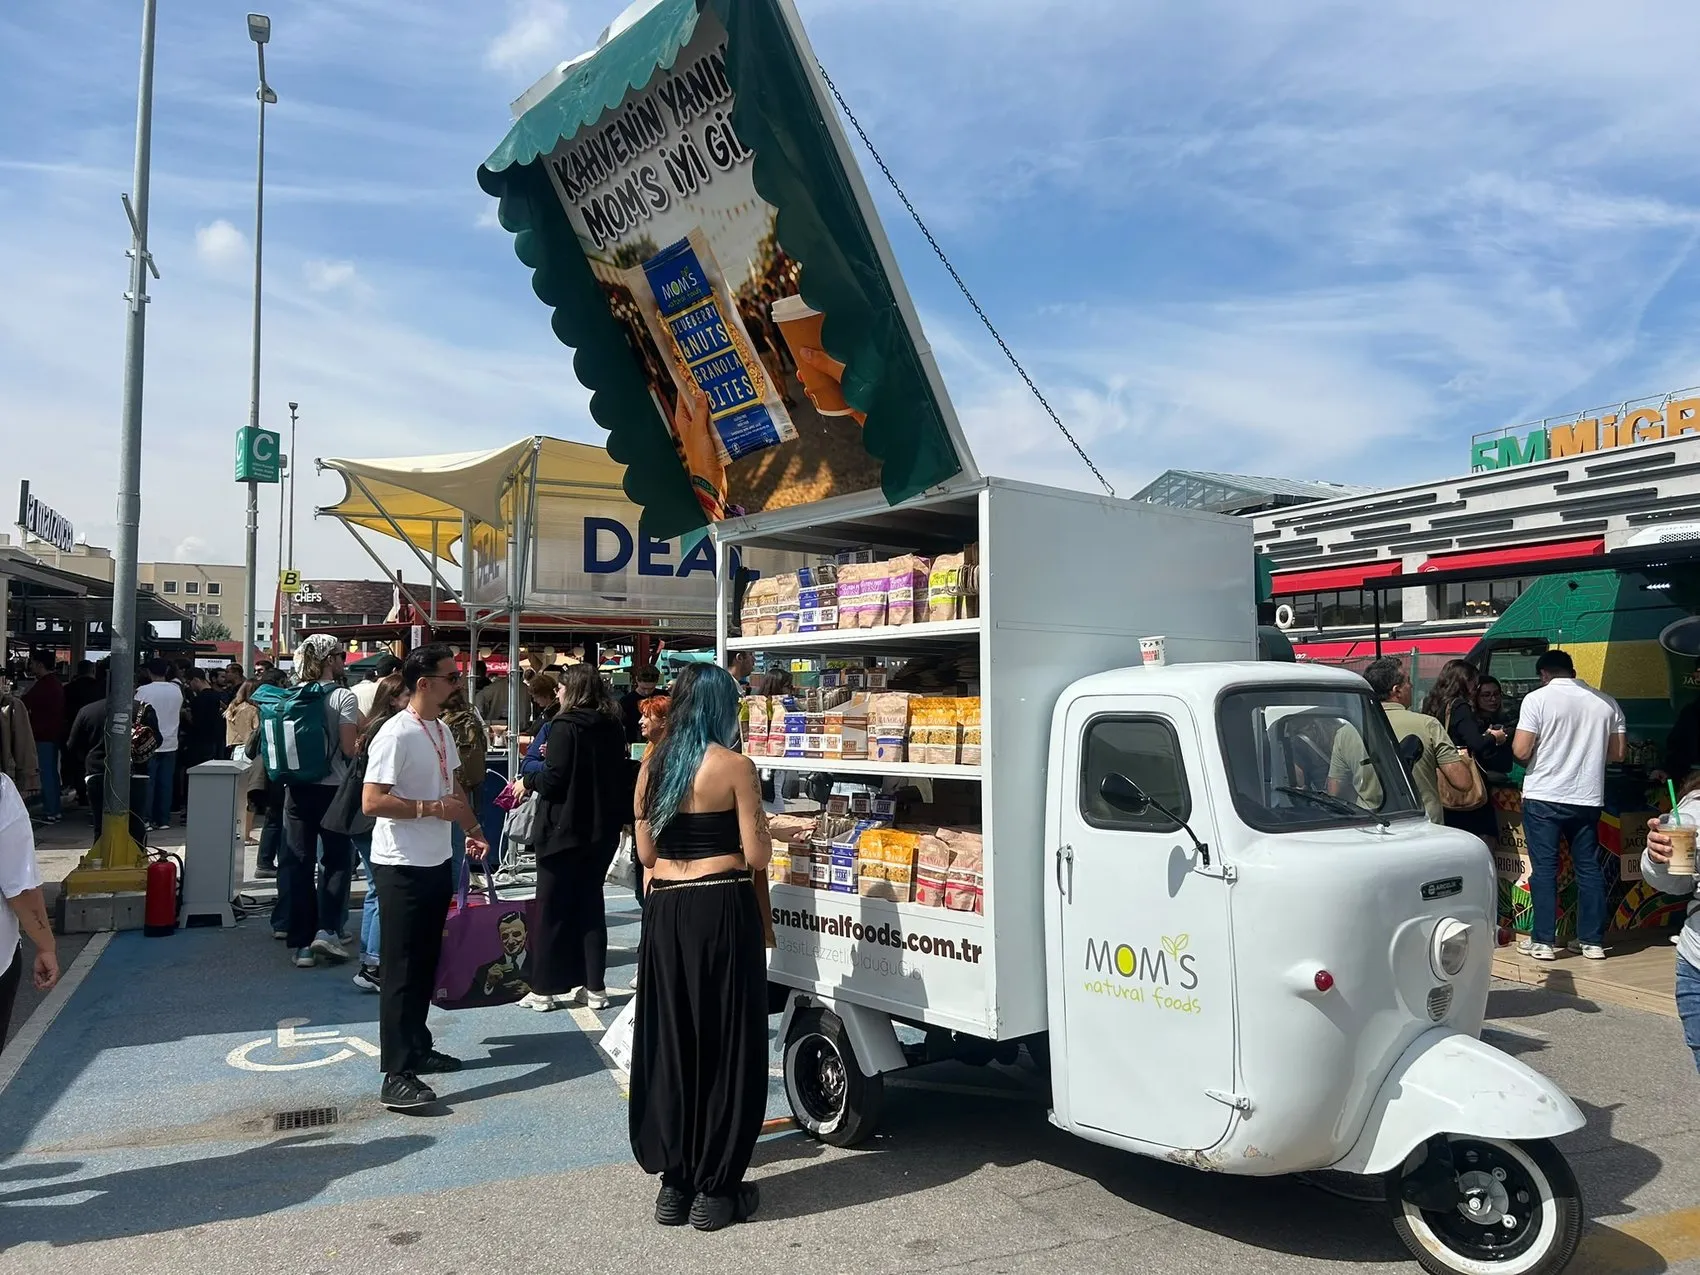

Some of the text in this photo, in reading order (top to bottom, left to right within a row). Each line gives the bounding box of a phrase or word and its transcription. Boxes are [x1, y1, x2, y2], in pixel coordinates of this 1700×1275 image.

[580, 167, 668, 248] MOM'S
[661, 271, 698, 301] MOM'S
[671, 305, 718, 336] BLUEBERRY
[693, 354, 744, 384] GRANOLA
[705, 375, 754, 410] BITES
[236, 431, 244, 462] C
[252, 433, 274, 461] C
[284, 572, 298, 585] B
[294, 592, 322, 603] CHEFS
[1084, 978, 1202, 1014] natural foods
